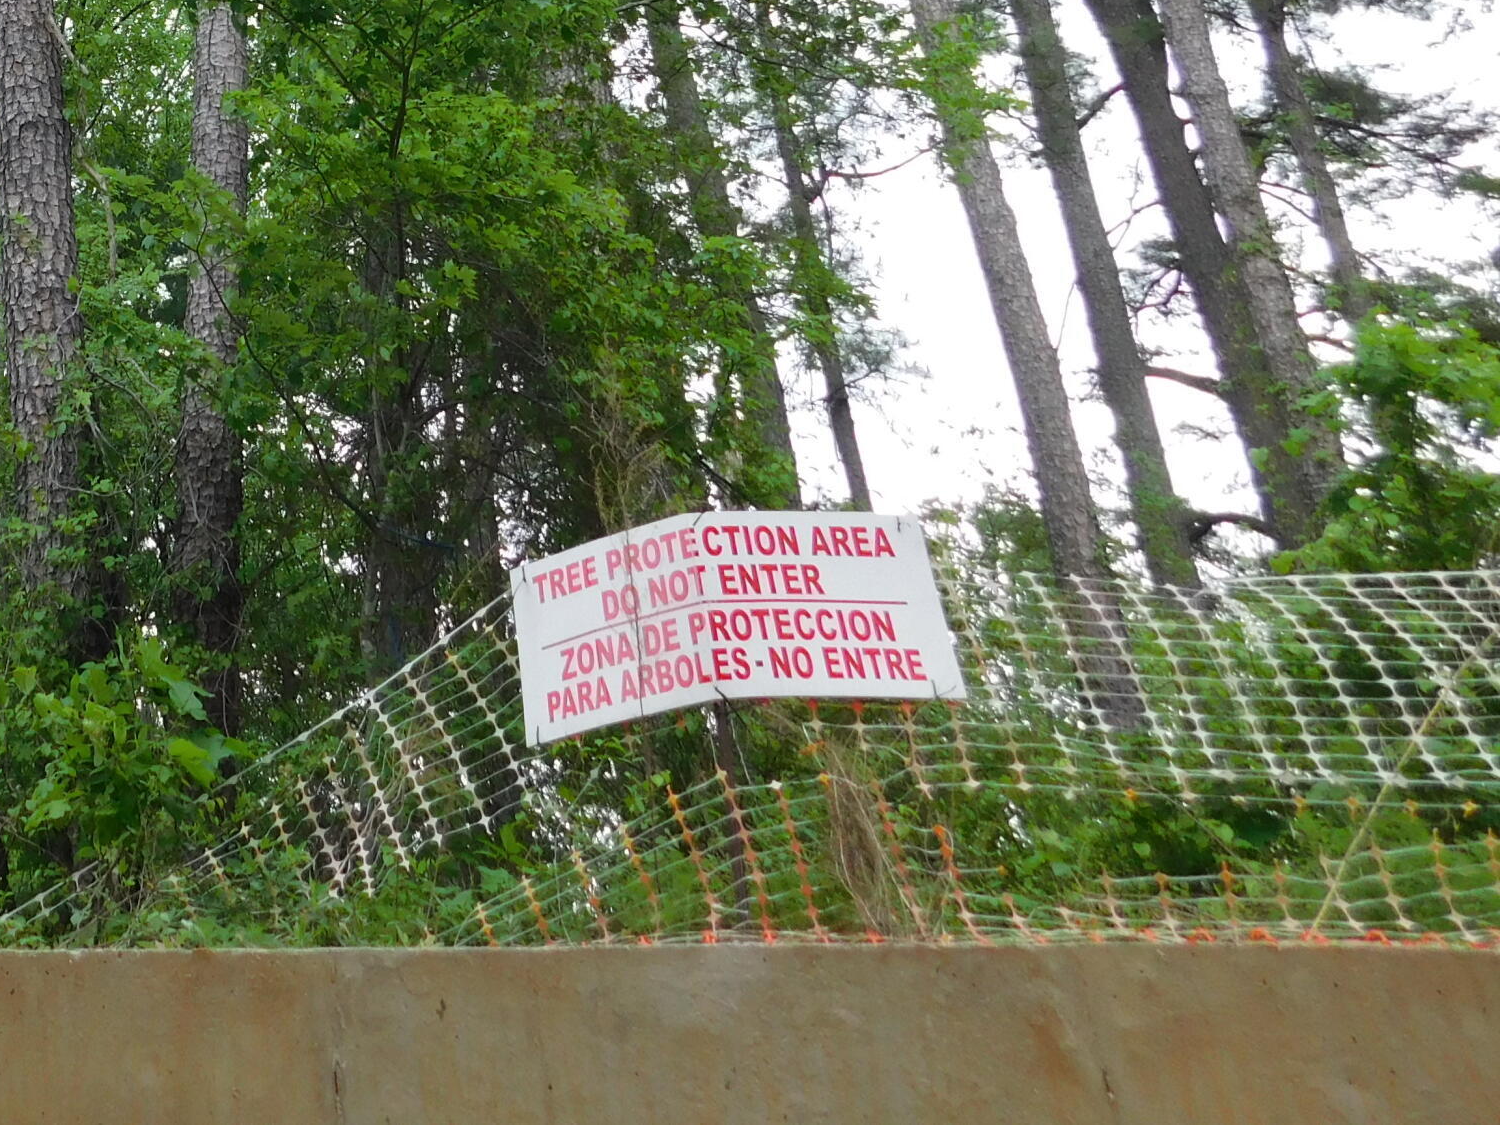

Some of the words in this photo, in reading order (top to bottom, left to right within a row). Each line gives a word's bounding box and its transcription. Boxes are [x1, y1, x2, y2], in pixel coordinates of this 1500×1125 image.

[532, 556, 598, 604] TREE
[605, 526, 800, 581] PROTECTION
[812, 526, 896, 558] AREA
[601, 584, 640, 621] DO
[647, 565, 706, 608] NOT
[717, 564, 825, 595] ENTER
[560, 632, 635, 681] ZONA
[642, 618, 681, 657] DE
[688, 609, 897, 646] PROTECCION
[547, 676, 613, 723] PARA
[821, 647, 928, 681] ENTRE
